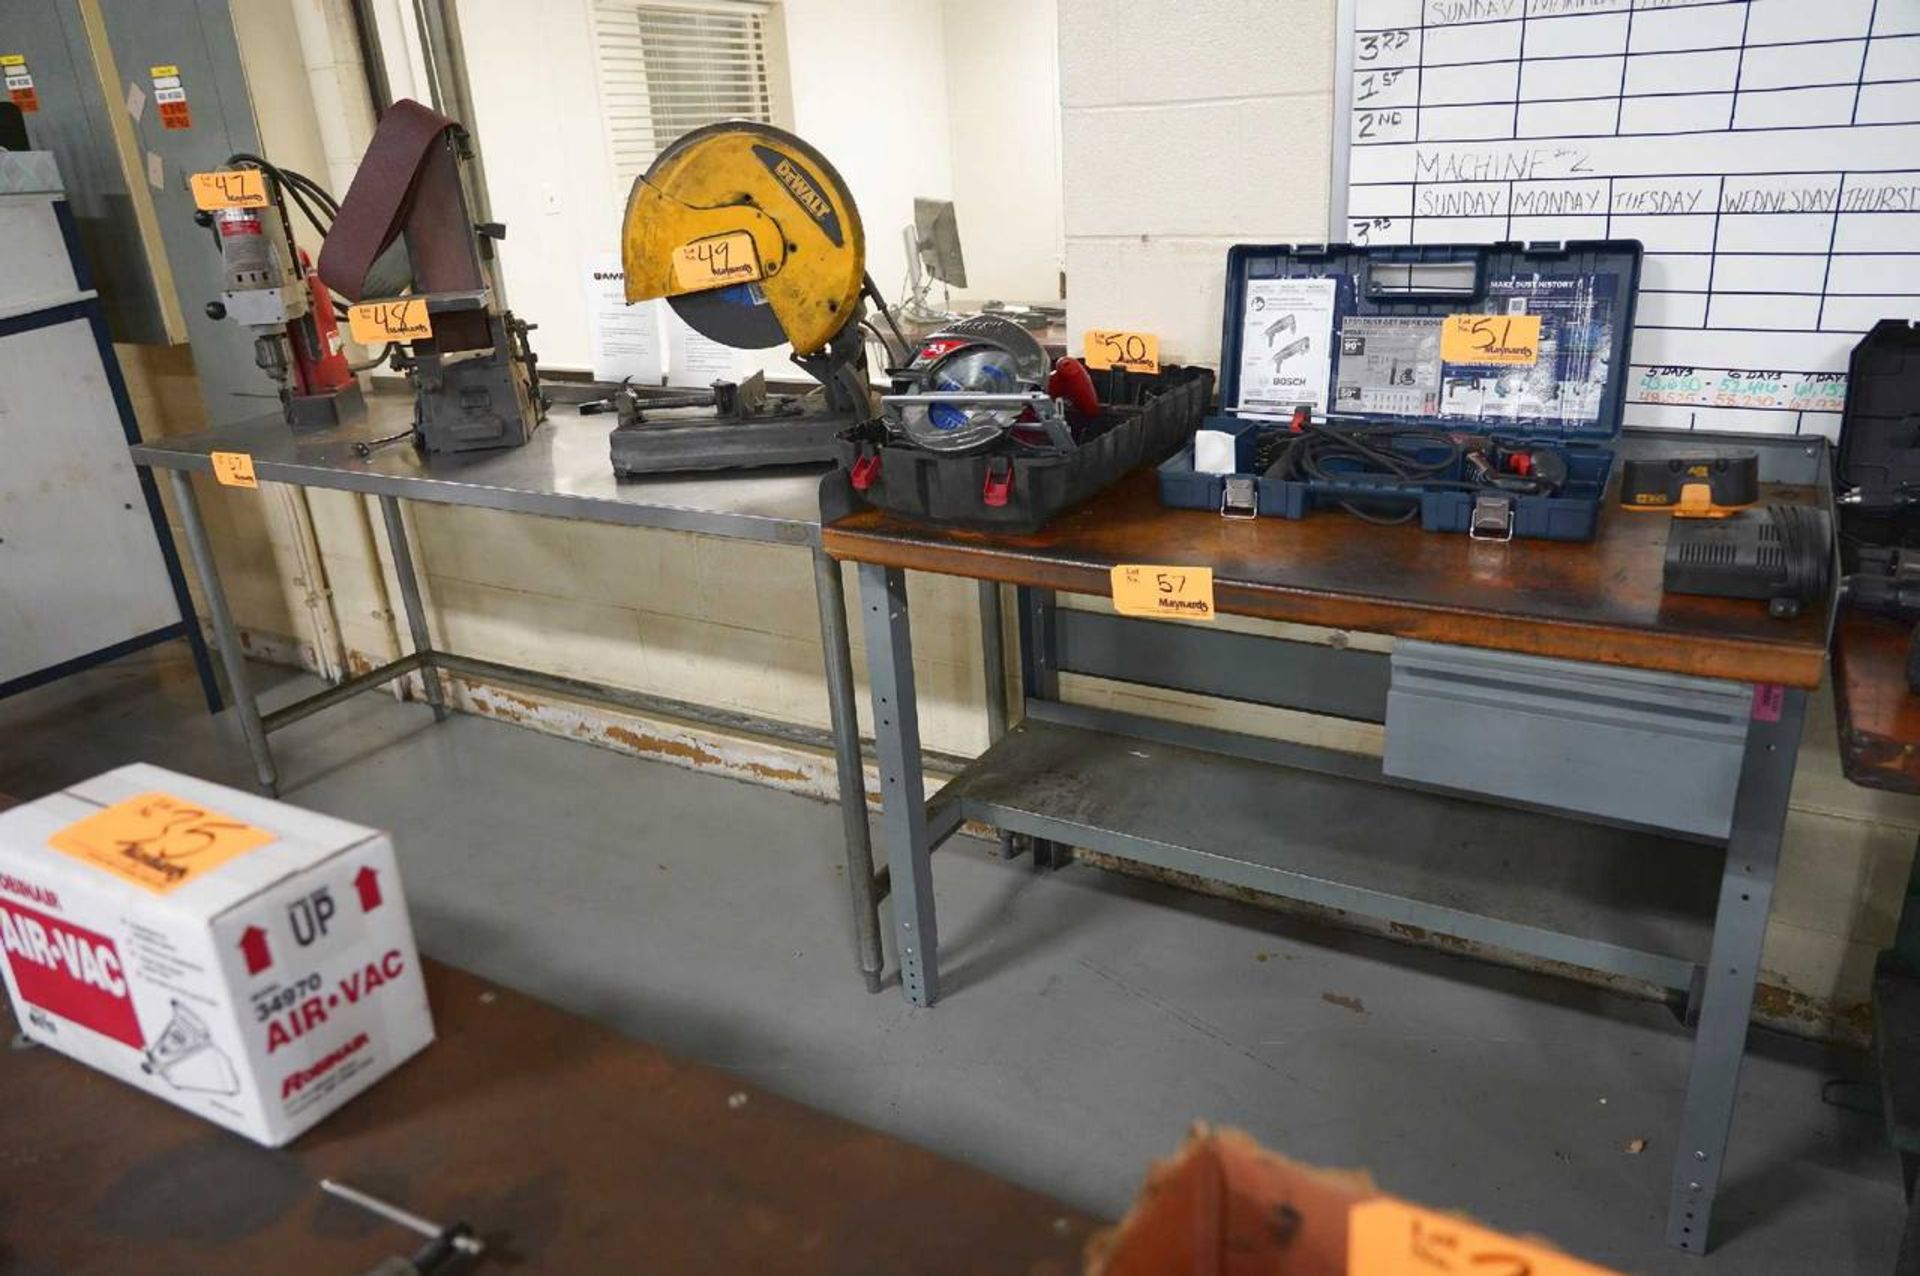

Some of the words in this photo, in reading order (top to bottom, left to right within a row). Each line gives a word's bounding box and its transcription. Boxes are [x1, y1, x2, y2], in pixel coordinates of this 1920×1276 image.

[1359, 31, 1410, 61] 3RD
[1357, 70, 1404, 101] 1ST
[1358, 111, 1402, 139] 2ND
[1415, 149, 1549, 181] MACHINE
[215, 173, 245, 201] 47
[773, 158, 832, 218] DEWALT
[1420, 190, 1501, 216] SUNDAY
[1514, 190, 1601, 215] MONDAY
[1613, 188, 1703, 214] TUESDAY
[1724, 187, 1837, 213] WEDNESDAY
[698, 240, 730, 274] 49
[1490, 280, 1514, 289] MAKE
[374, 300, 411, 334] 48
[1105, 333, 1146, 363] 50
[1471, 317, 1511, 350] 51
[1273, 377, 1307, 386] BOSCH
[1645, 367, 1657, 378] 5
[1660, 366, 1694, 377] DAYS
[1727, 369, 1742, 379] 6
[1745, 371, 1783, 381] DAYS
[1156, 573, 1186, 593] 57
[1158, 598, 1209, 613] Maynards
[288, 885, 336, 948] UP
[255, 972, 322, 1023] 34970
